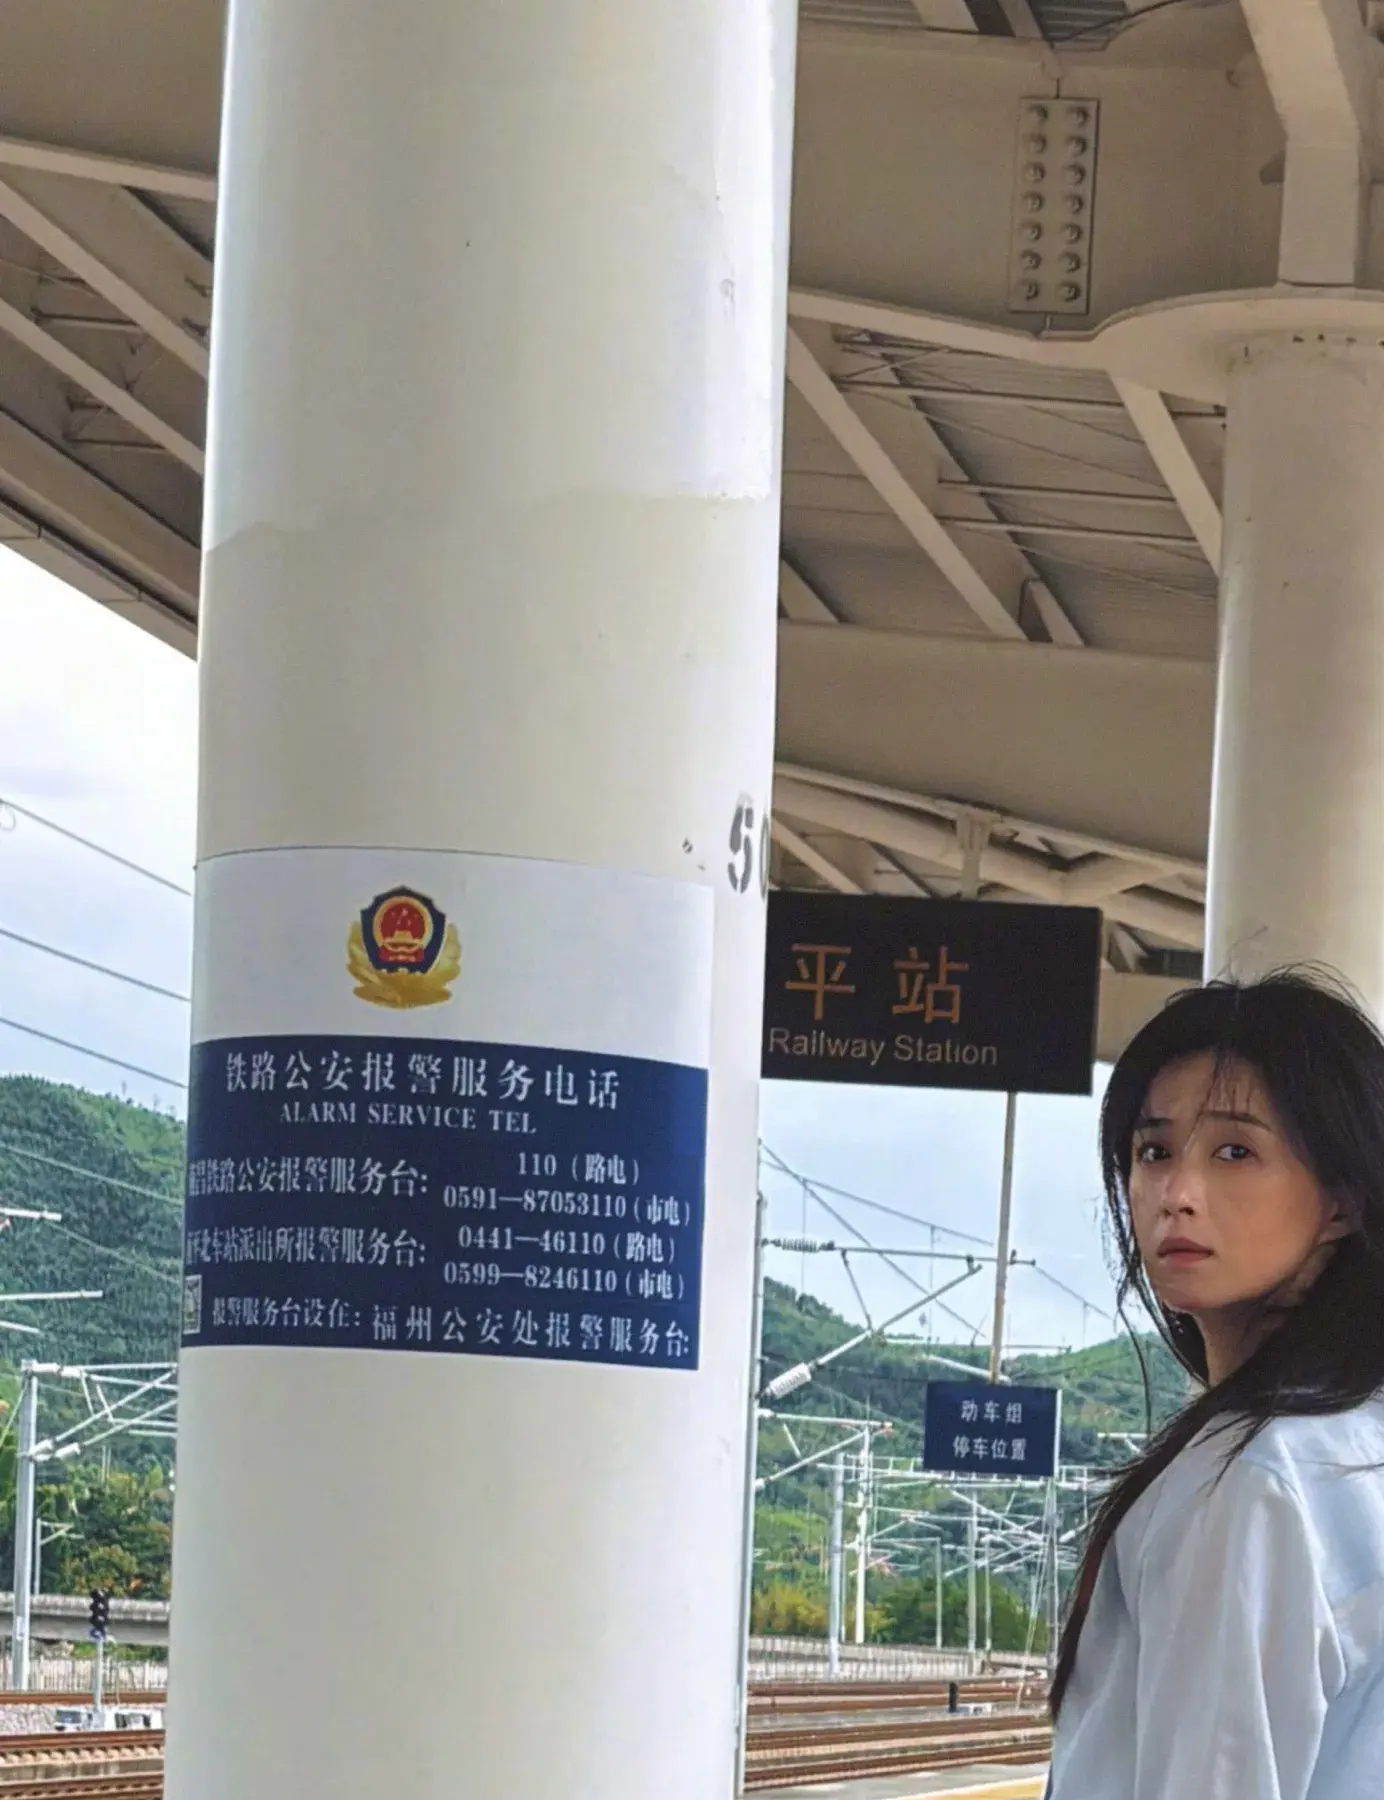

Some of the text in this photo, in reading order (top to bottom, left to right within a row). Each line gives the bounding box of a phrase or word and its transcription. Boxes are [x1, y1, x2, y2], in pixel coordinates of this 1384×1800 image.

[785, 944, 970, 1025] 平站
[769, 1028, 998, 1066] Railway Station
[226, 1050, 619, 1110] 铁路公安报警服务电话
[280, 1101, 537, 1134] ALARM SERVICE TEL
[961, 1399, 1023, 1424] 动车组
[952, 1435, 1028, 1461] 停车位置
